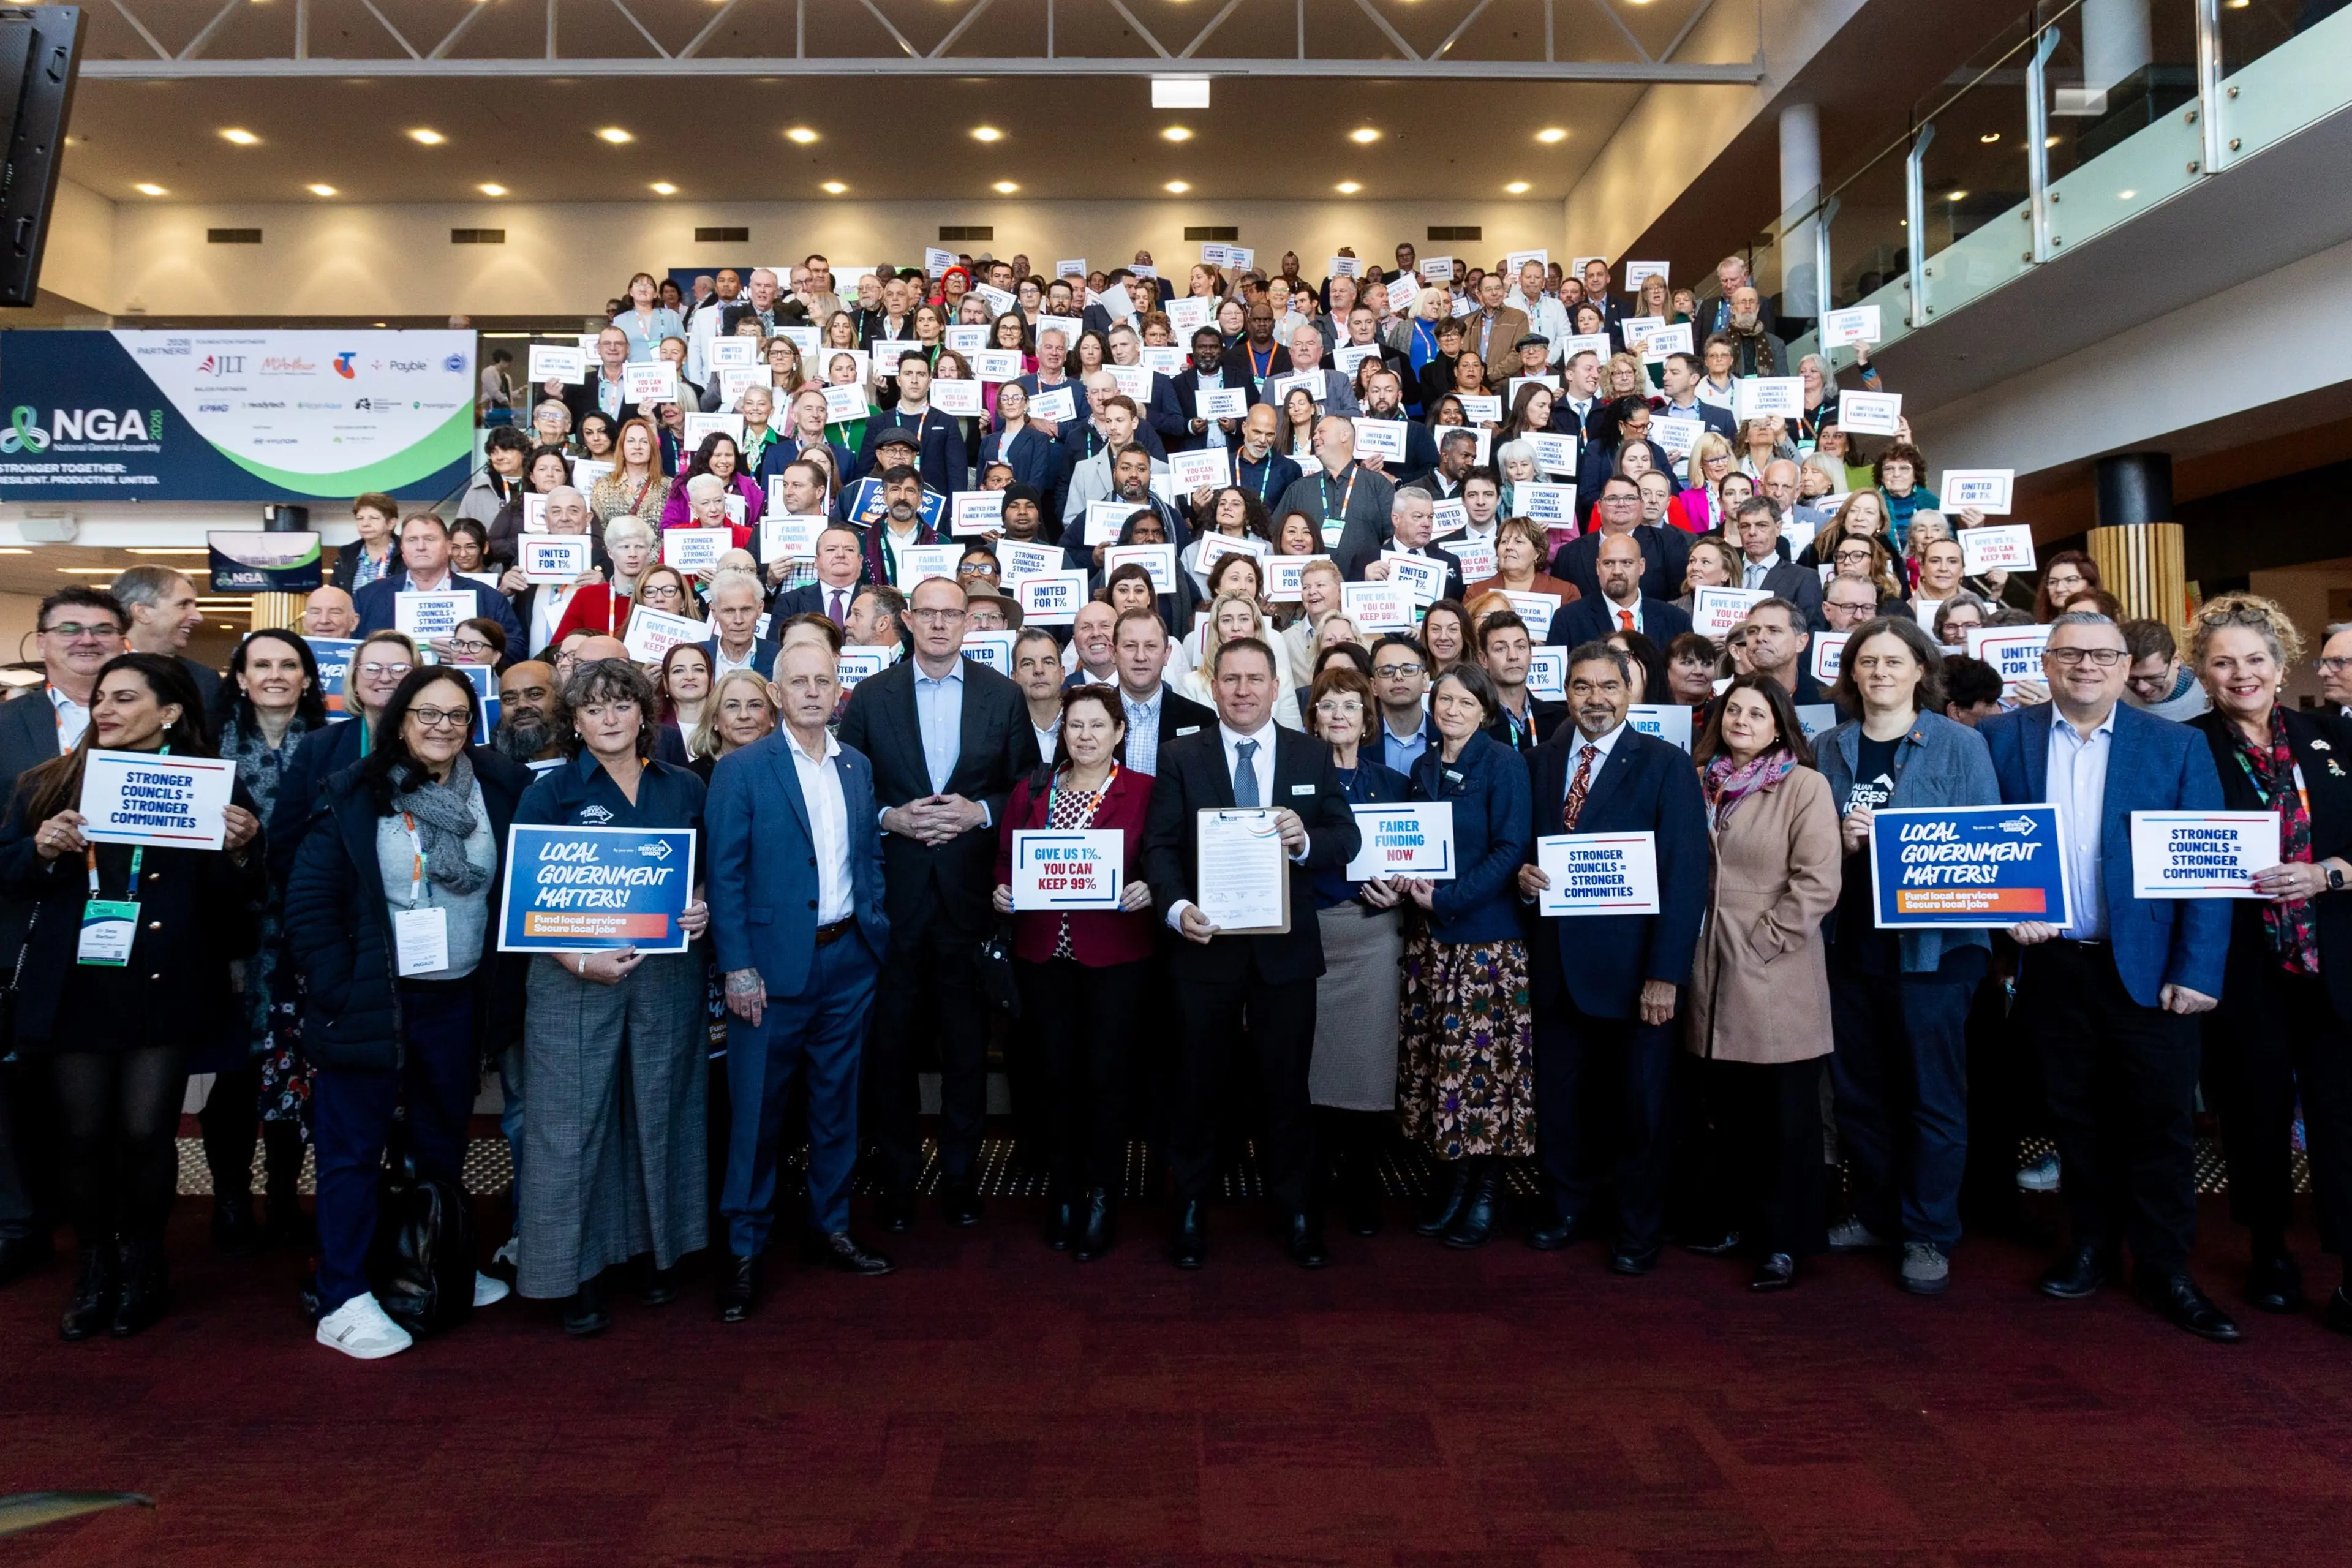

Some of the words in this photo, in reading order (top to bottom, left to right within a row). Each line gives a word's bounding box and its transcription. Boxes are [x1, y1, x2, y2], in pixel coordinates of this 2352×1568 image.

[215, 355, 247, 378] JLT
[390, 360, 427, 373] Payble
[53, 408, 148, 440] NGA
[150, 409, 164, 440] 2026
[1435, 510, 1460, 519] UNITED
[539, 549, 570, 558] UNITED
[1015, 551, 1045, 561] STRONGER
[539, 560, 555, 568] FOR
[559, 560, 571, 568] 1%
[1012, 558, 1040, 567] COUNCILS
[1400, 565, 1428, 579] UNITED
[233, 573, 265, 584] NGA
[1415, 579, 1426, 589] 1%
[1034, 586, 1066, 596] UNITED
[1034, 598, 1051, 608] FOR
[1054, 597, 1067, 607] 1%
[1710, 598, 1728, 607] GIVE
[1731, 600, 1740, 609] US
[1716, 609, 1731, 618] YOU
[646, 620, 665, 633] GIVE
[668, 625, 679, 636] US
[1711, 619, 1732, 627] KEEP
[650, 632, 666, 644] YOU
[643, 641, 665, 653] KEEP
[1528, 663, 1548, 673] ITED
[2002, 662, 2027, 674] FOR
[1536, 674, 1549, 684] 1%
[126, 771, 193, 787] STRONGER
[121, 785, 183, 800] COUNCILS
[123, 799, 188, 814] STRONGER
[111, 812, 197, 828] COMMUNITIES
[1379, 820, 1419, 833] FAIRER
[1899, 821, 1960, 842] LOCAL
[1375, 834, 1425, 847] FUNDING
[2171, 829, 2238, 840] STRONGER
[539, 842, 599, 864] LOCAL
[1901, 842, 2042, 864] GOVERNMENT
[2169, 842, 2230, 853] COUNCILS
[1035, 848, 1060, 860] GIVE
[1063, 848, 1078, 860] US
[1082, 848, 1101, 861] 1%.
[1387, 849, 1414, 861] NOW
[1569, 850, 1623, 861] STRONGER
[2172, 855, 2237, 866] STRONGER
[1044, 863, 1066, 875] YOU
[1069, 862, 1092, 875] CAN
[1568, 862, 1617, 873] COUNCILS
[2163, 868, 2248, 879] COMMUNITIES
[537, 864, 674, 886] GOVERNMENT
[1571, 874, 1624, 886] STRONGER
[1902, 864, 1999, 886] MATTERS!
[1038, 878, 1068, 890] KEEP
[1071, 877, 1096, 890] 99%
[535, 887, 631, 909] MATTERS!
[1564, 886, 1634, 898] COMMUNITIES
[1905, 892, 1929, 901] Fund
[1931, 891, 1954, 900] local
[1956, 891, 1999, 900] services
[1905, 900, 1940, 910] Secure
[1942, 900, 1965, 908] local
[1966, 900, 1989, 910] jobs
[534, 914, 559, 924] Fund
[561, 915, 584, 924] local
[586, 916, 627, 925] services
[533, 924, 570, 933] Secure
[571, 924, 594, 933] local
[595, 925, 616, 935] jobs
